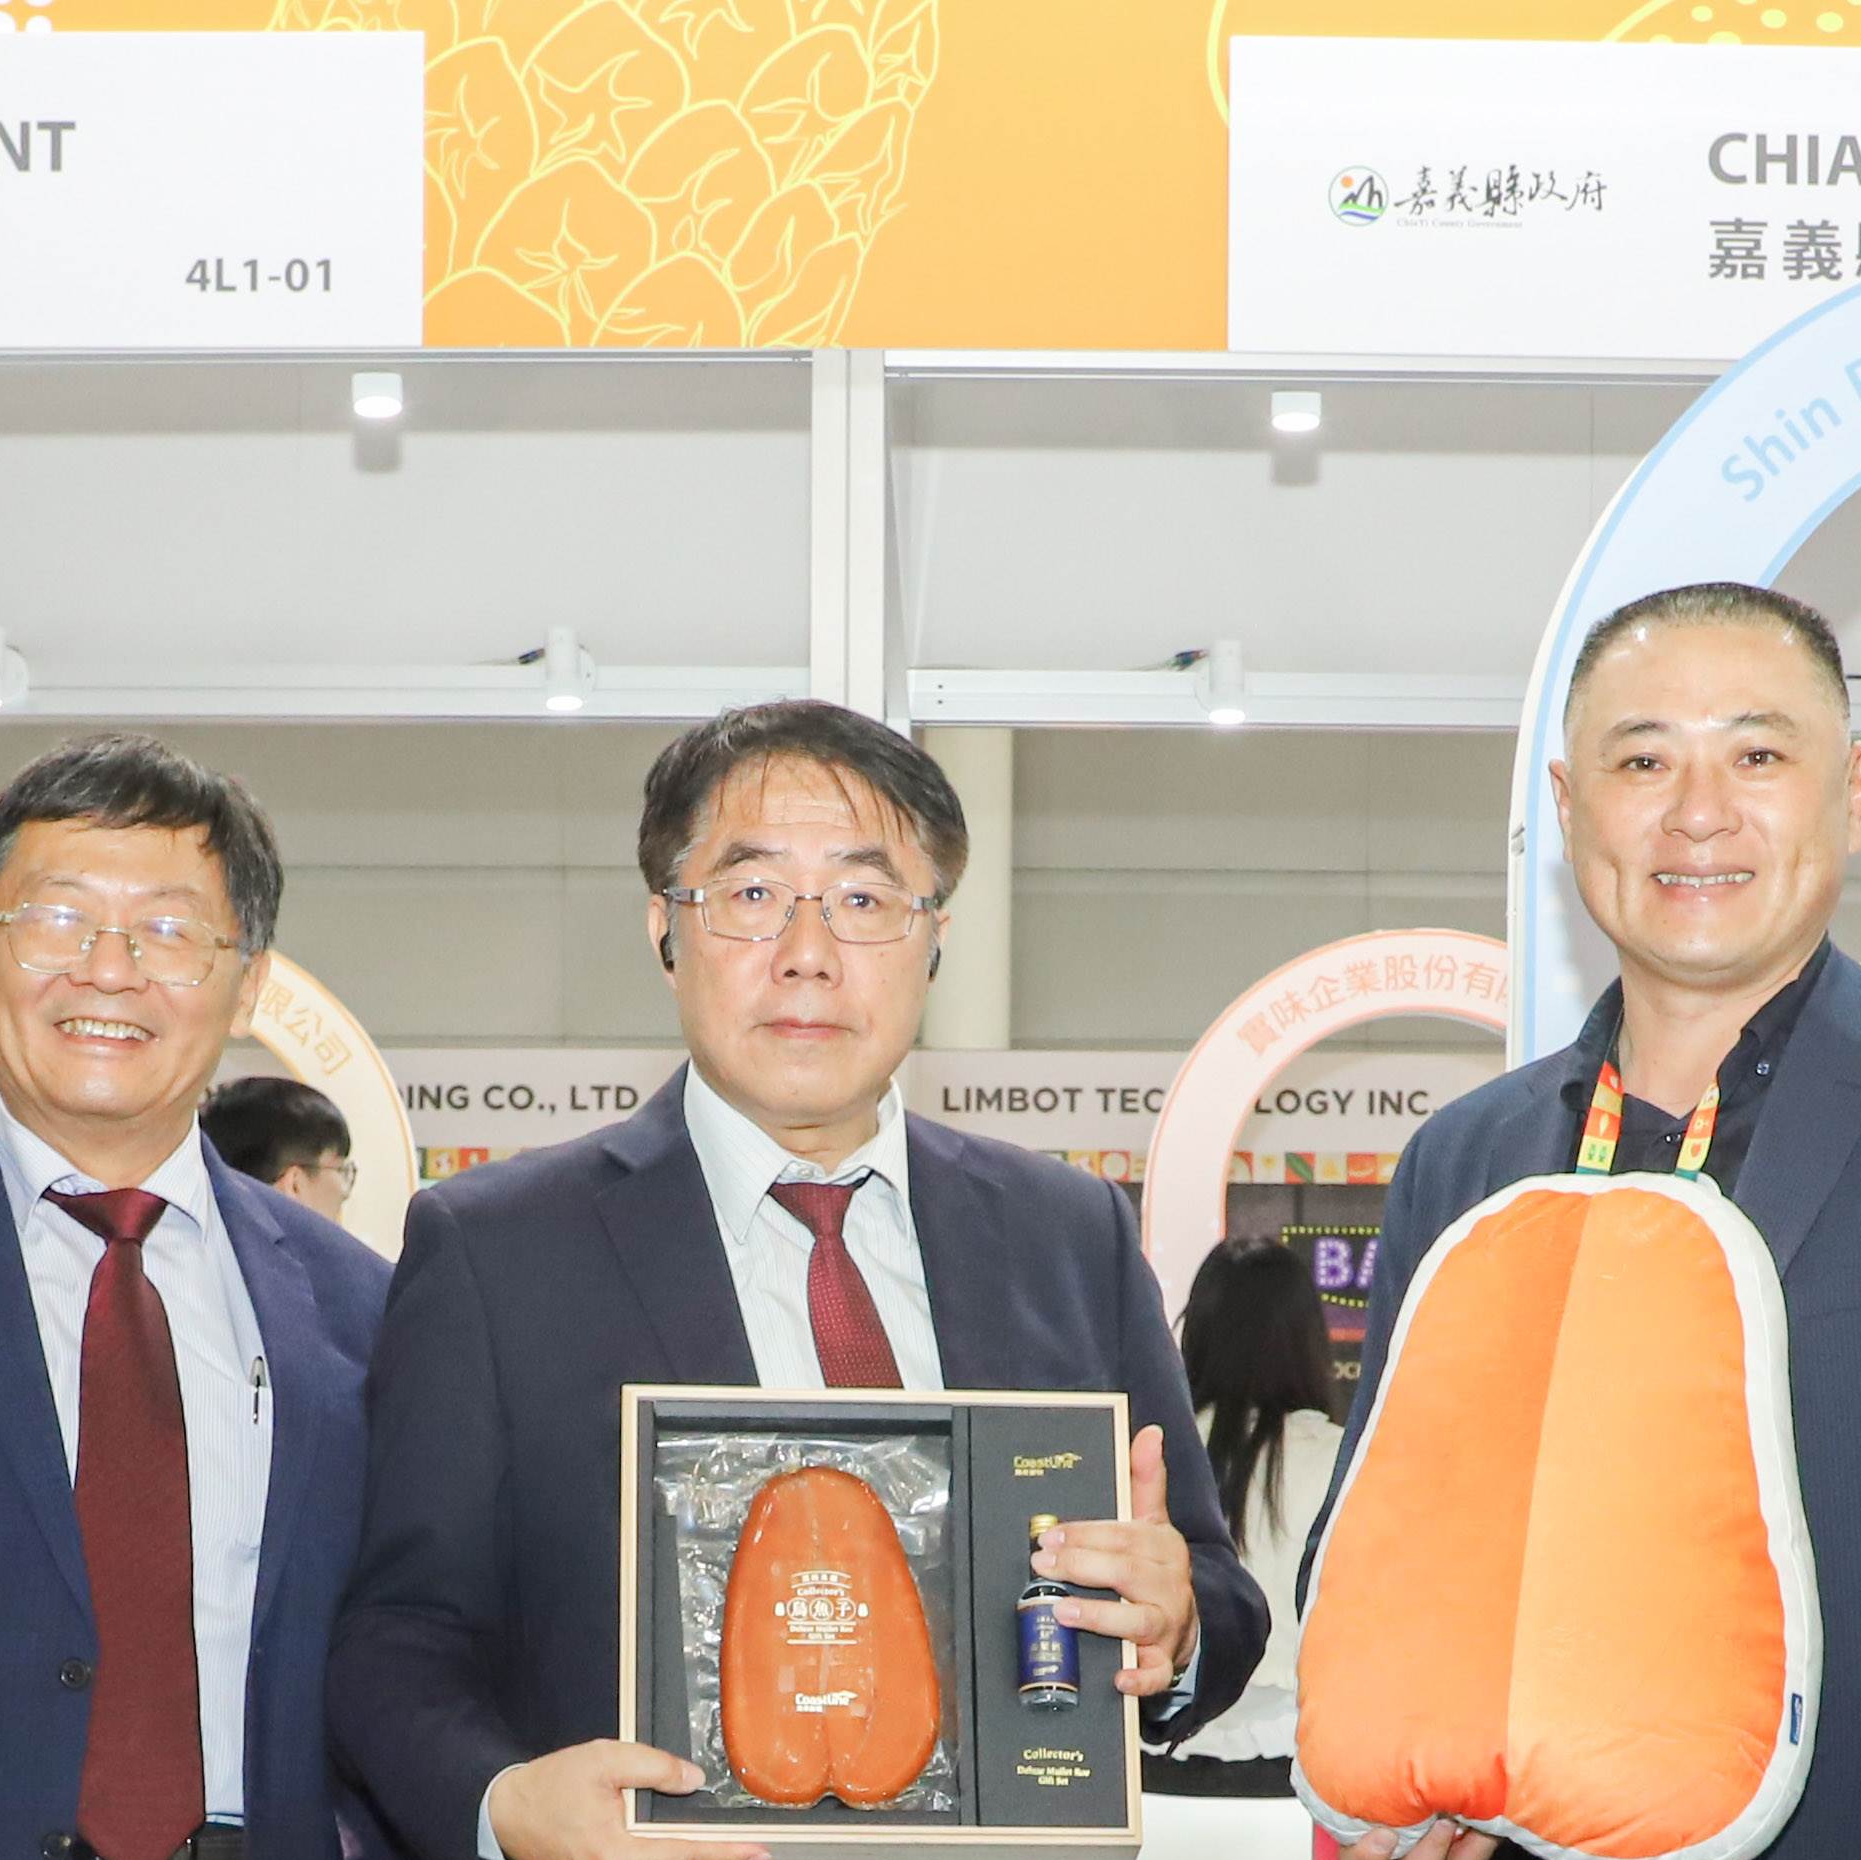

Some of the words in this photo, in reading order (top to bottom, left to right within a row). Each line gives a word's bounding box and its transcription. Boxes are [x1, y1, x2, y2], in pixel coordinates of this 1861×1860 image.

[1393, 164, 1607, 218] 嘉義縣政府
[186, 258, 335, 293] 4L1-01
[1721, 395, 1842, 504] Shin
[484, 1085, 558, 1114] CO.,
[942, 1087, 1083, 1114] LIMBOT
[1366, 1089, 1437, 1116] INC.
[1022, 1747, 1085, 1763] Collector's
